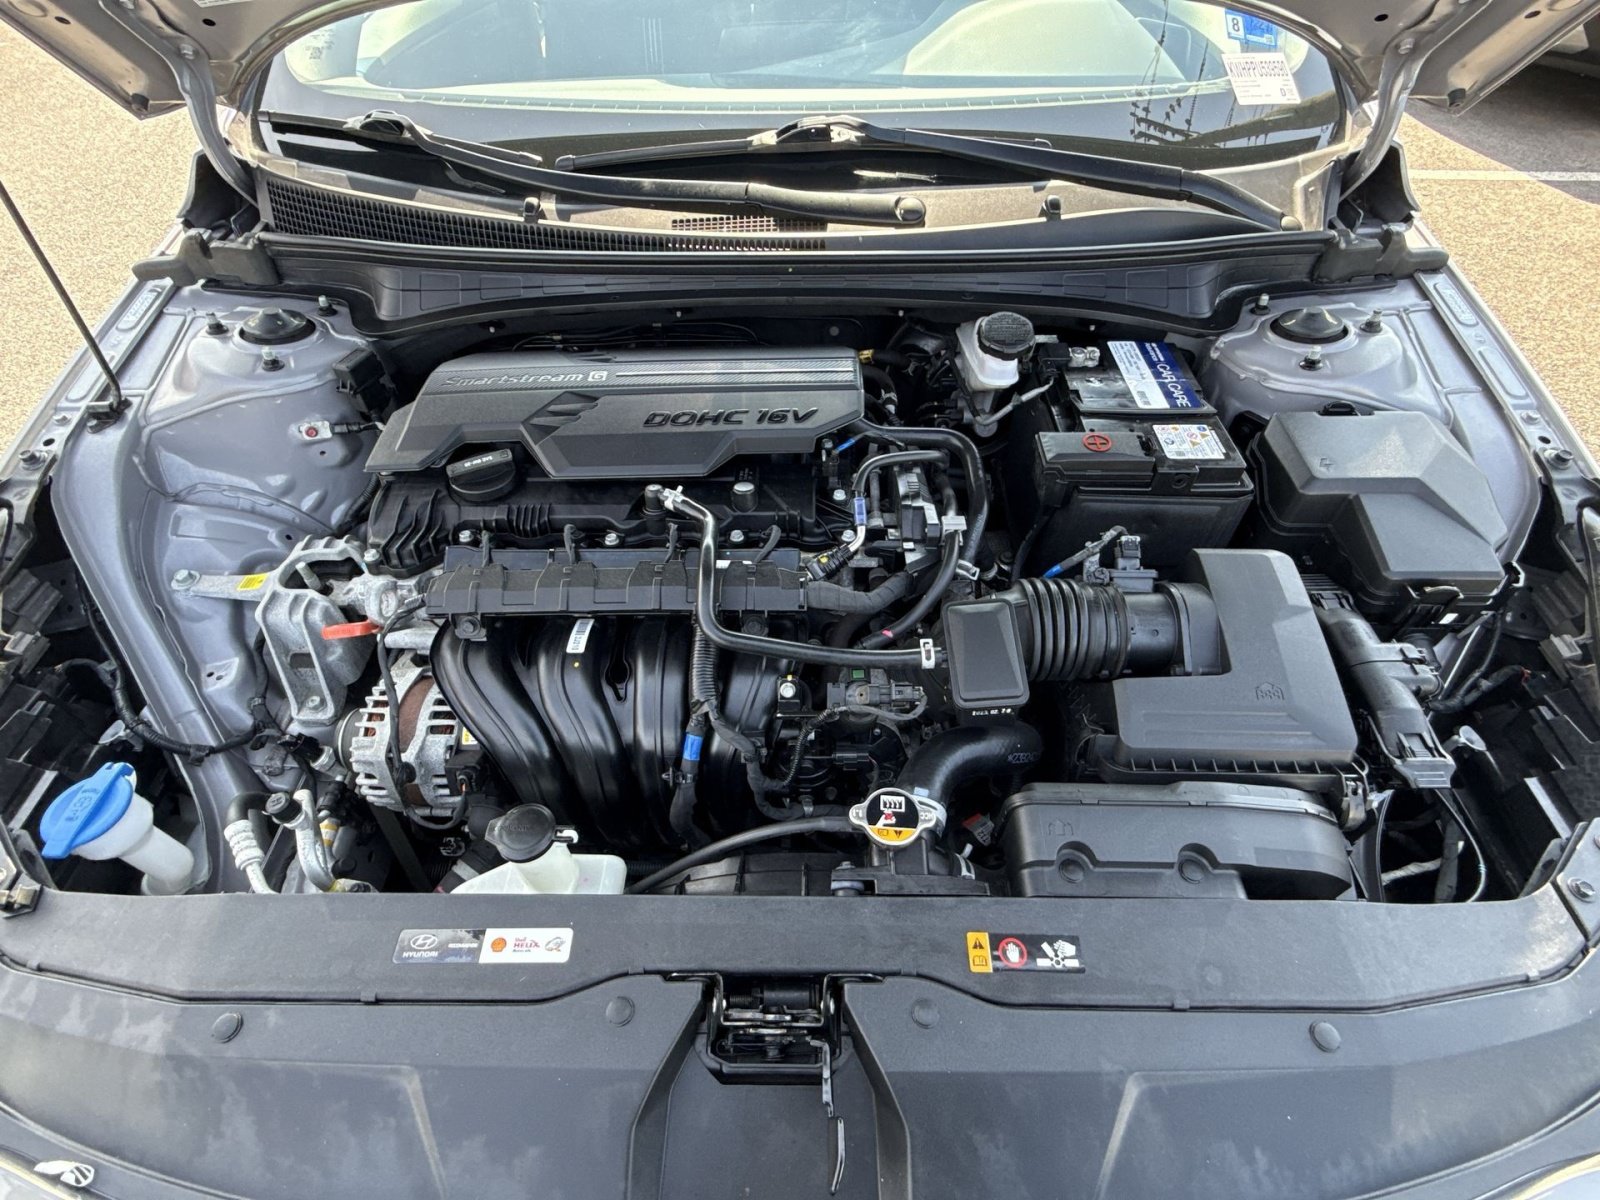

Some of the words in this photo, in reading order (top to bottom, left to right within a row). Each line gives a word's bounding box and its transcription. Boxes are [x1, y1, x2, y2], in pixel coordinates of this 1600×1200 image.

[1232, 17, 1240, 32] 8
[441, 371, 584, 387] Smartstream
[1157, 363, 1177, 383] CAR
[1168, 383, 1191, 407] CARE
[642, 409, 750, 428] DOHC
[756, 407, 819, 425] 16V
